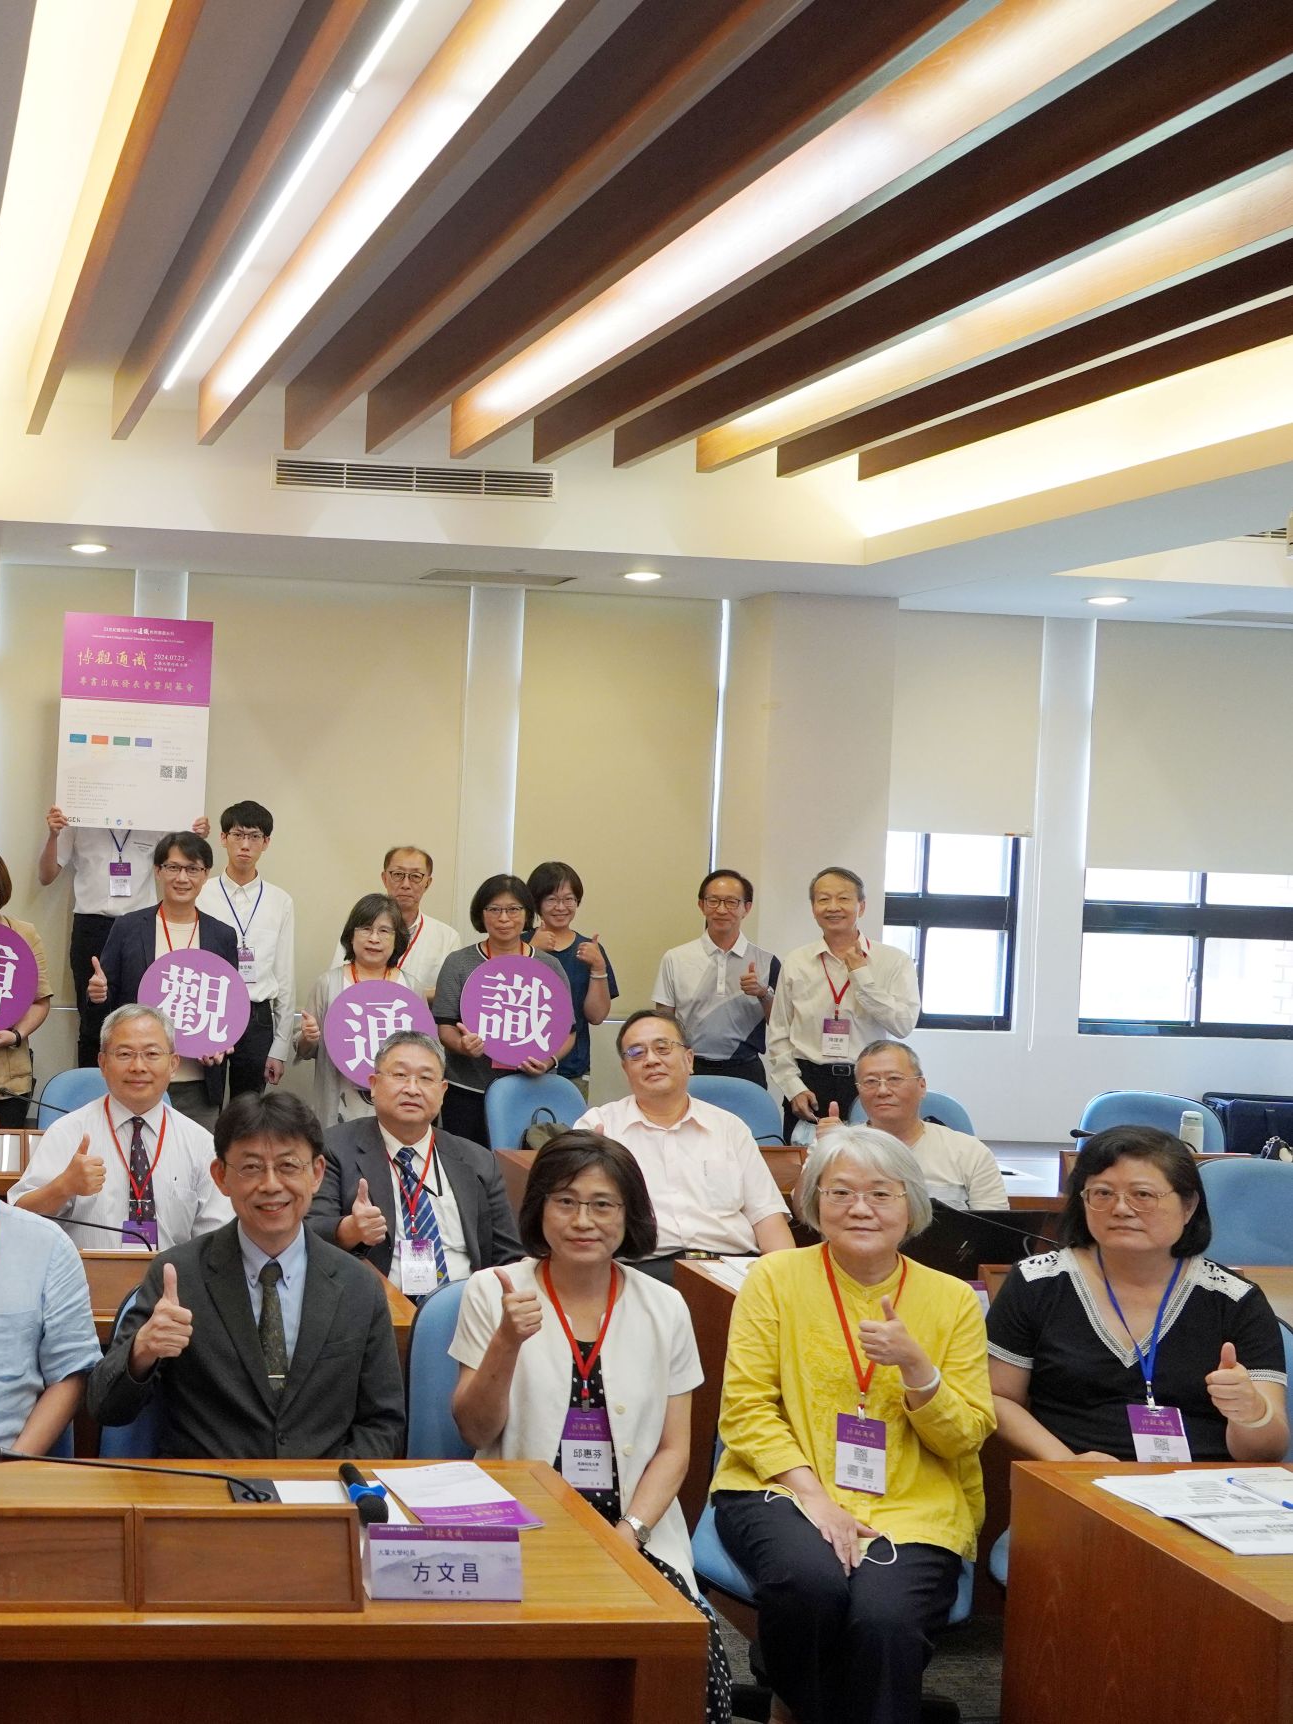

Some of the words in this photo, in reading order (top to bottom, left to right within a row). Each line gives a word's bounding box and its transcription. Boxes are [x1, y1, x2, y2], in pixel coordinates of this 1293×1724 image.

[76, 647, 148, 671] 博觀通識
[157, 964, 230, 1043] 觀
[478, 972, 553, 1052] 識
[344, 999, 413, 1072] 通
[573, 1448, 602, 1459] 邱惠芬
[411, 1562, 479, 1583] 方文昌
